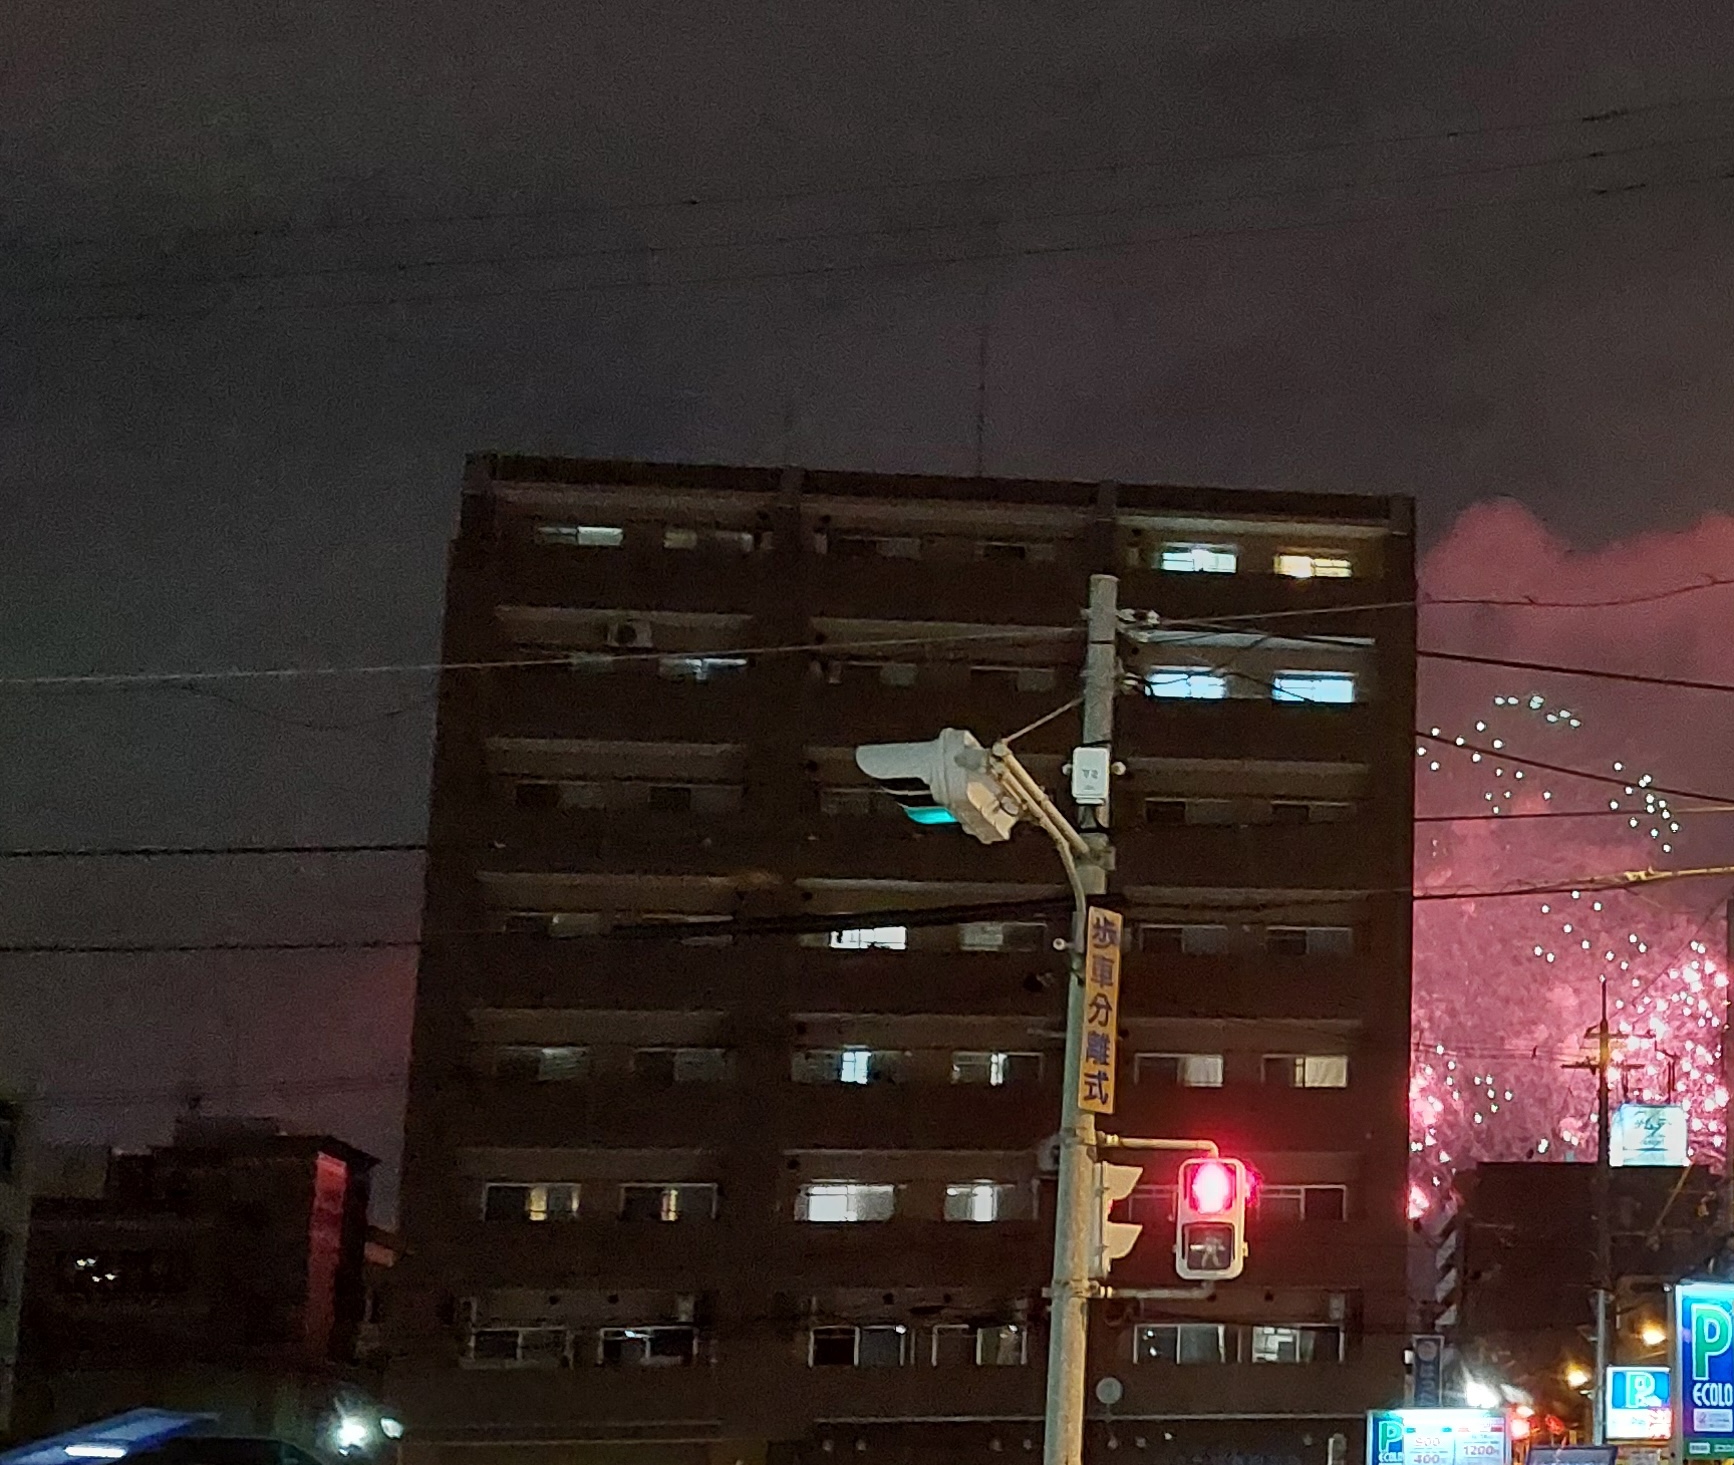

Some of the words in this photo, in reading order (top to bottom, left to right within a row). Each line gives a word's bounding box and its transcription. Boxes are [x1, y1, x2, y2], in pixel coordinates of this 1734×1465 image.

[1083, 915, 1121, 1106] 歩車分離式
[1692, 1382, 1733, 1407] ECOLO
